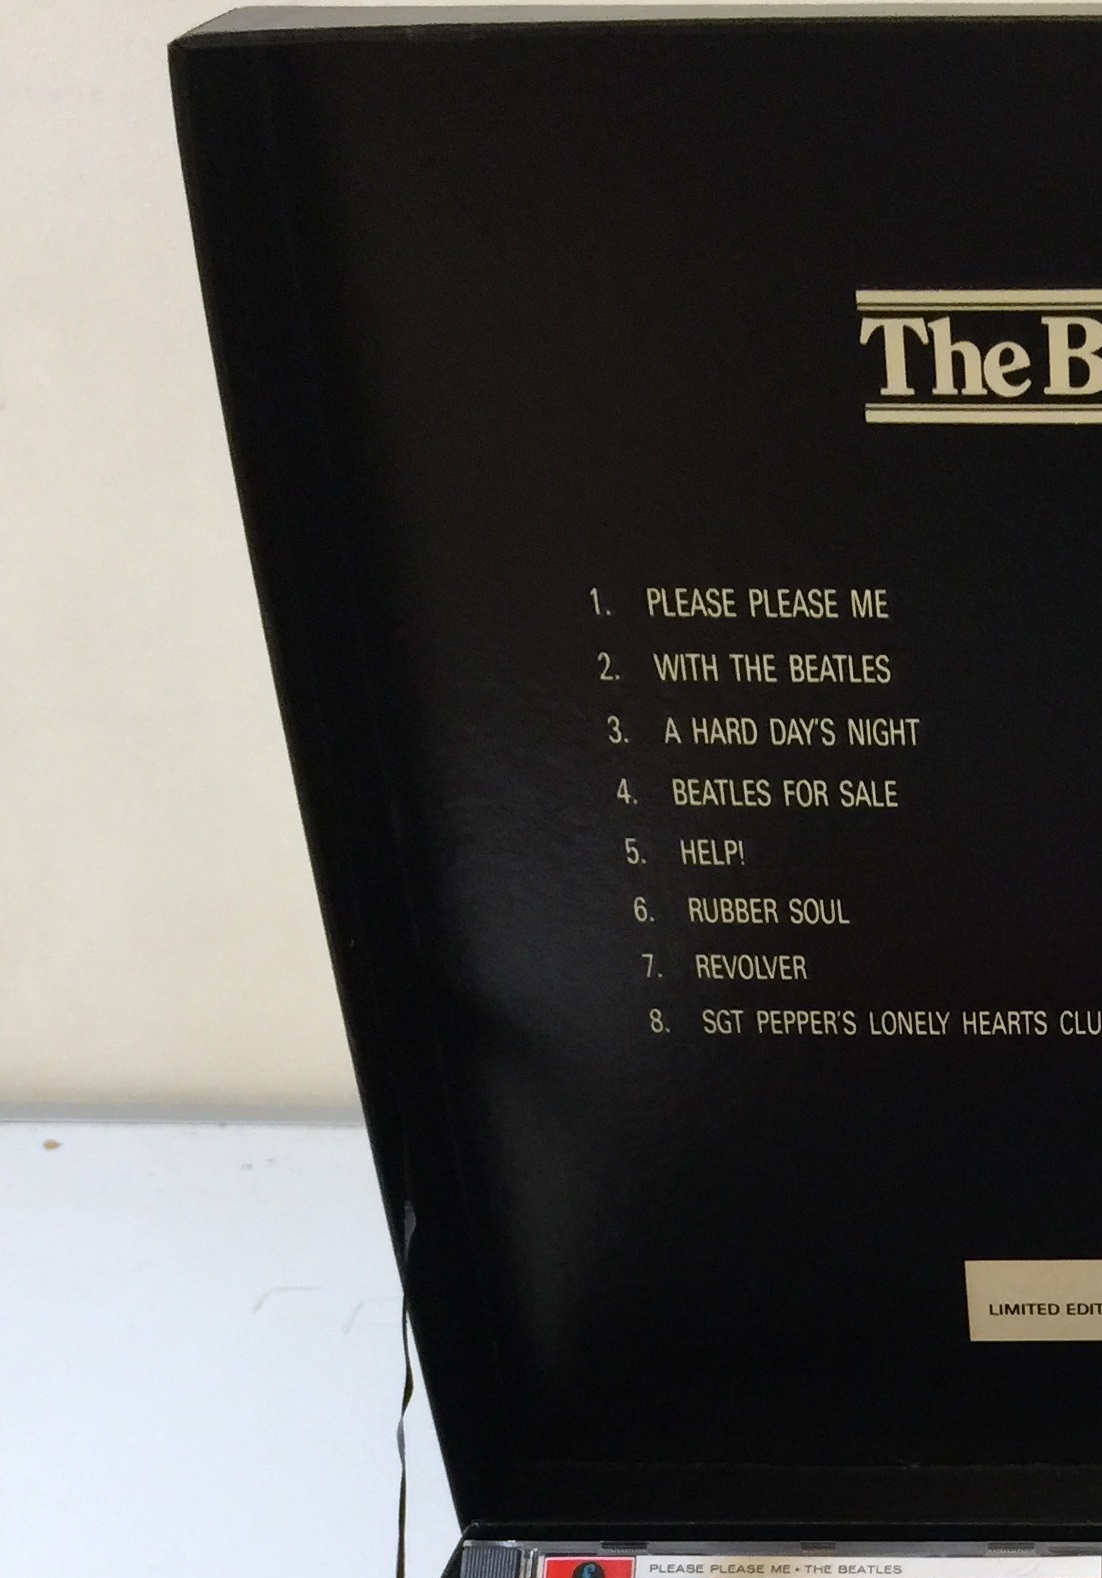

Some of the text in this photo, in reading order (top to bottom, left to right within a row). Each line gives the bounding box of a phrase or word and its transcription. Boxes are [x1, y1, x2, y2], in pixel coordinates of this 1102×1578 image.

[859, 316, 1031, 397] The
[589, 587, 889, 619] 1. PLEASE PLEASE ME
[597, 651, 891, 684] 2. WITH THE BEATLES
[607, 715, 920, 747] 3. A HARD DAY'S NIGHT
[616, 777, 899, 808] 4. BEATLES FOR SALE
[624, 837, 745, 866] 5. HELP!
[633, 896, 851, 925] 6. RUBBER SOUL
[641, 953, 808, 980] 7. REVOLVER
[649, 1008, 671, 1034] 8.
[701, 1008, 744, 1034] SGT
[756, 1010, 857, 1036] PEPPER'S
[869, 1010, 951, 1036] LONELY
[962, 1010, 1048, 1036] HEARTS
[988, 1302, 1061, 1317] LIMITED
[649, 1563, 903, 1575] PLEASE PLEASE ME THE BEATLES
